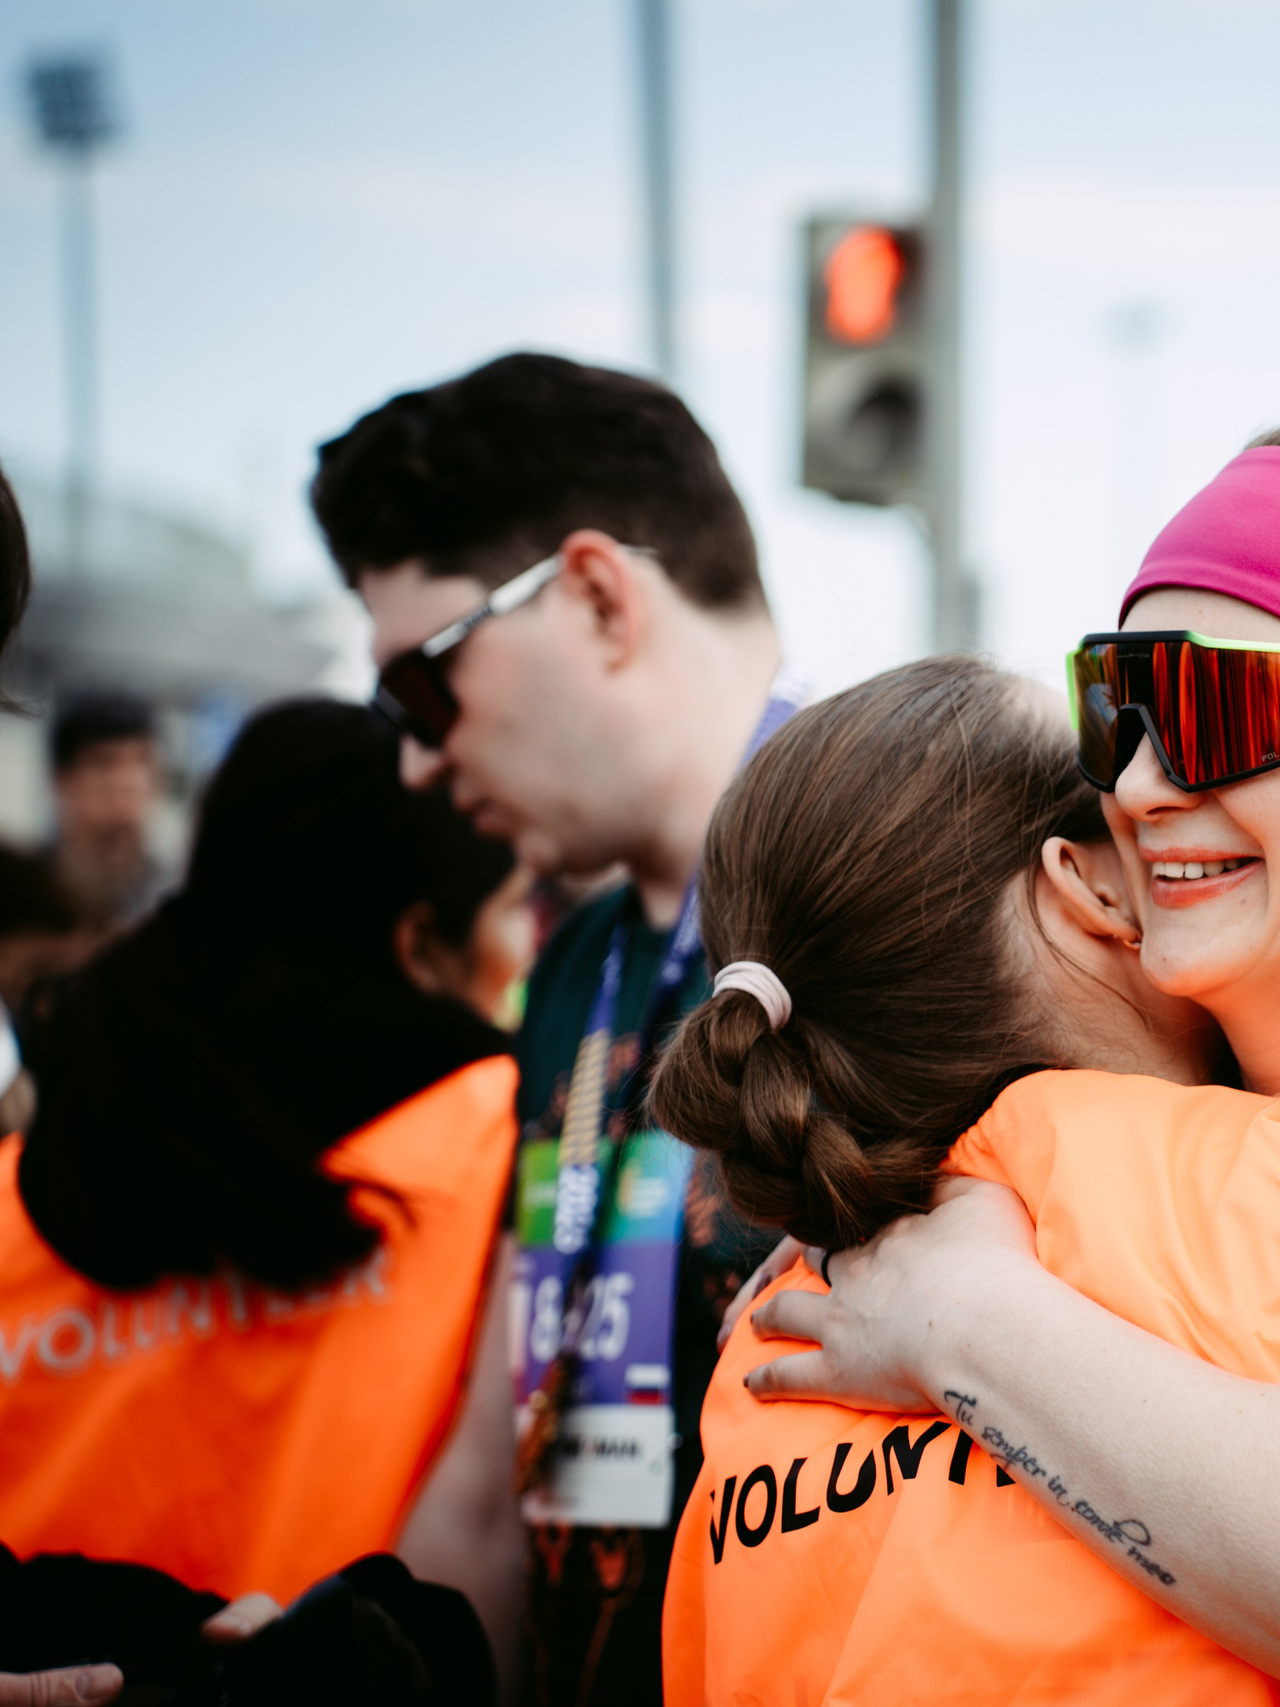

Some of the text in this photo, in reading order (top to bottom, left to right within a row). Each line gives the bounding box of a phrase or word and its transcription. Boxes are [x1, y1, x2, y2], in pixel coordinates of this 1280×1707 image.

[944, 1390, 977, 1426] Tu
[982, 1426, 1047, 1476] semper
[1048, 1476, 1070, 1507] in
